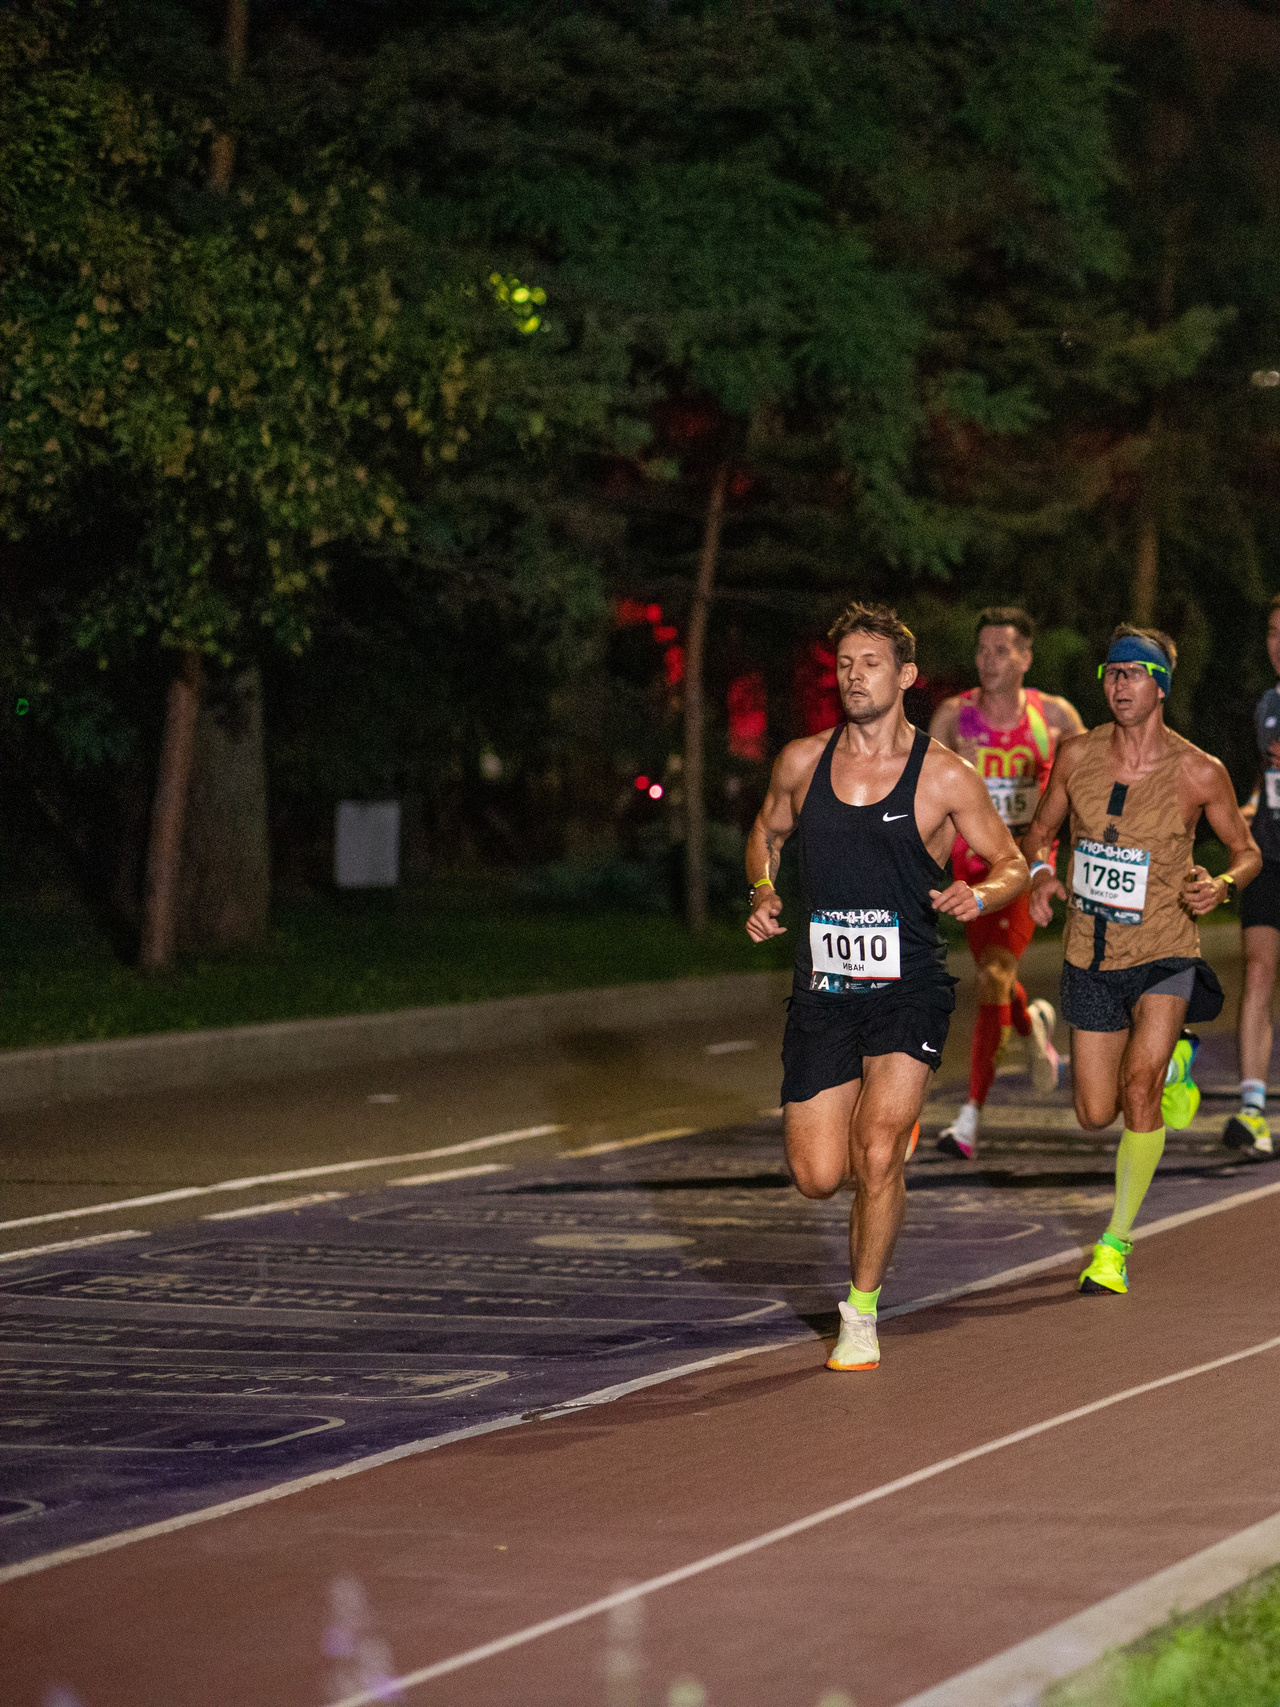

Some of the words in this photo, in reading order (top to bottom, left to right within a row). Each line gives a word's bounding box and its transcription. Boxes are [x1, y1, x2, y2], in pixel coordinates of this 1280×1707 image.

[1083, 861, 1136, 893] 1785
[1090, 888, 1119, 899] ВИКТОР
[822, 932, 887, 962] 1010
[842, 962, 865, 971] ИВАН
